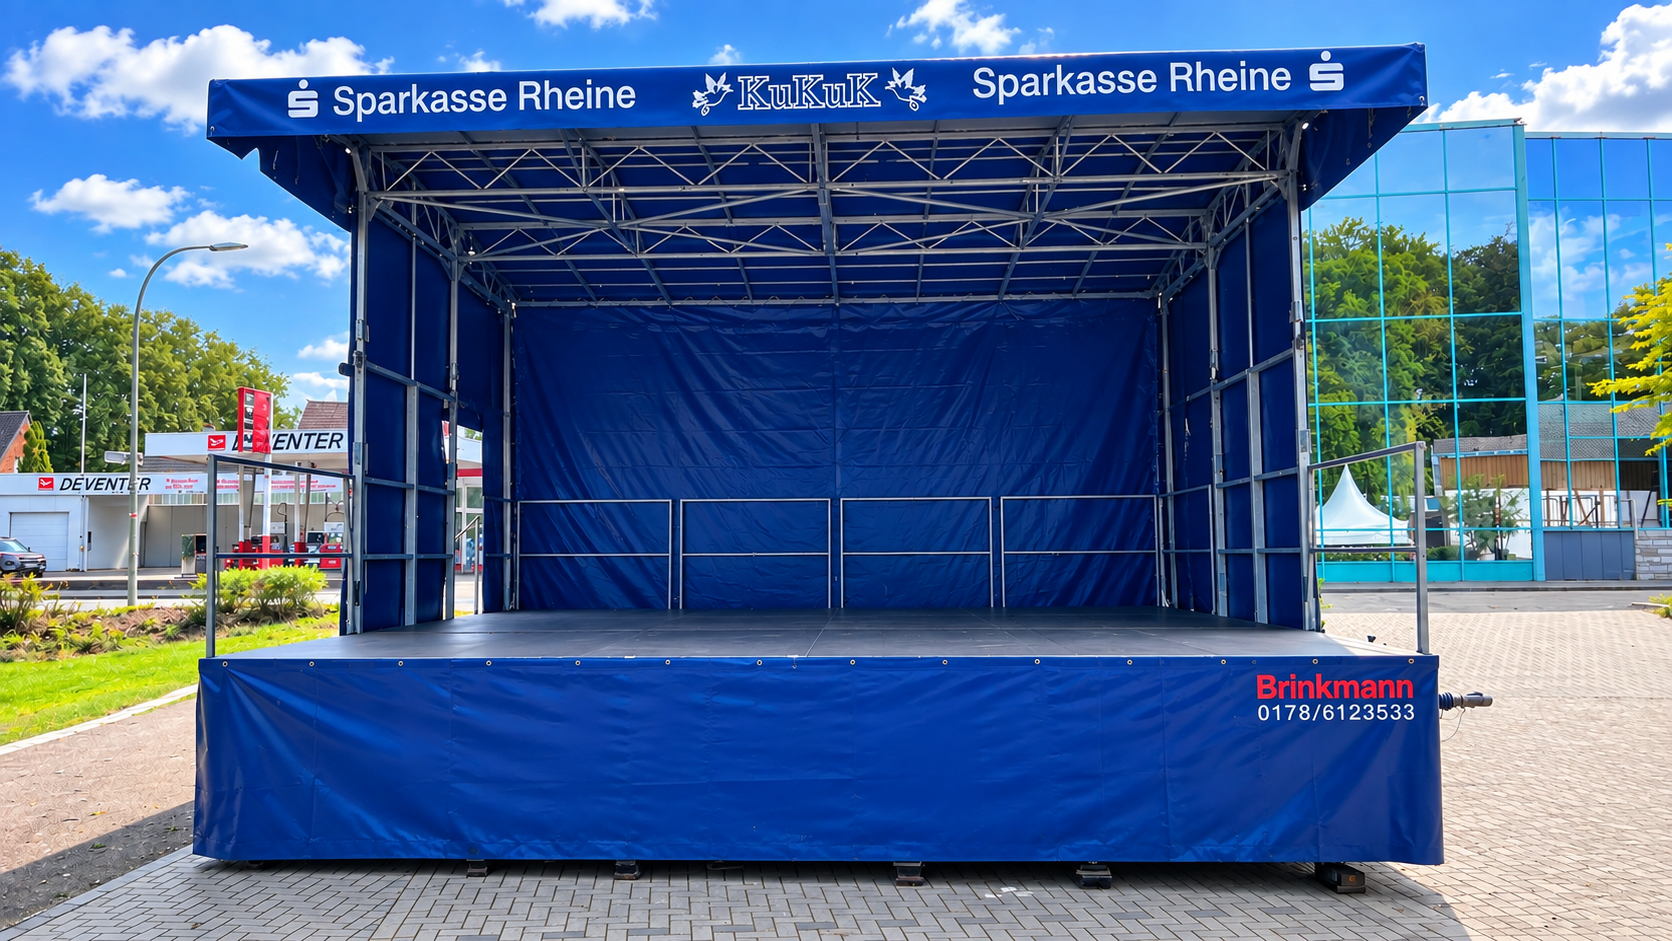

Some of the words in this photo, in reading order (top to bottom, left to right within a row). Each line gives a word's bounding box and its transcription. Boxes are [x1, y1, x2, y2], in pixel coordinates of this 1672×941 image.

[737, 73, 881, 111] KuKuK
[973, 64, 1157, 105] Sparkasse
[1170, 60, 1291, 92] Rheine
[333, 84, 507, 122] Sparkasse
[518, 79, 636, 111] Rheine
[231, 432, 344, 451] ENTER
[1256, 673, 1414, 699] Brinkmann
[1257, 704, 1415, 721] 0178/6123533
